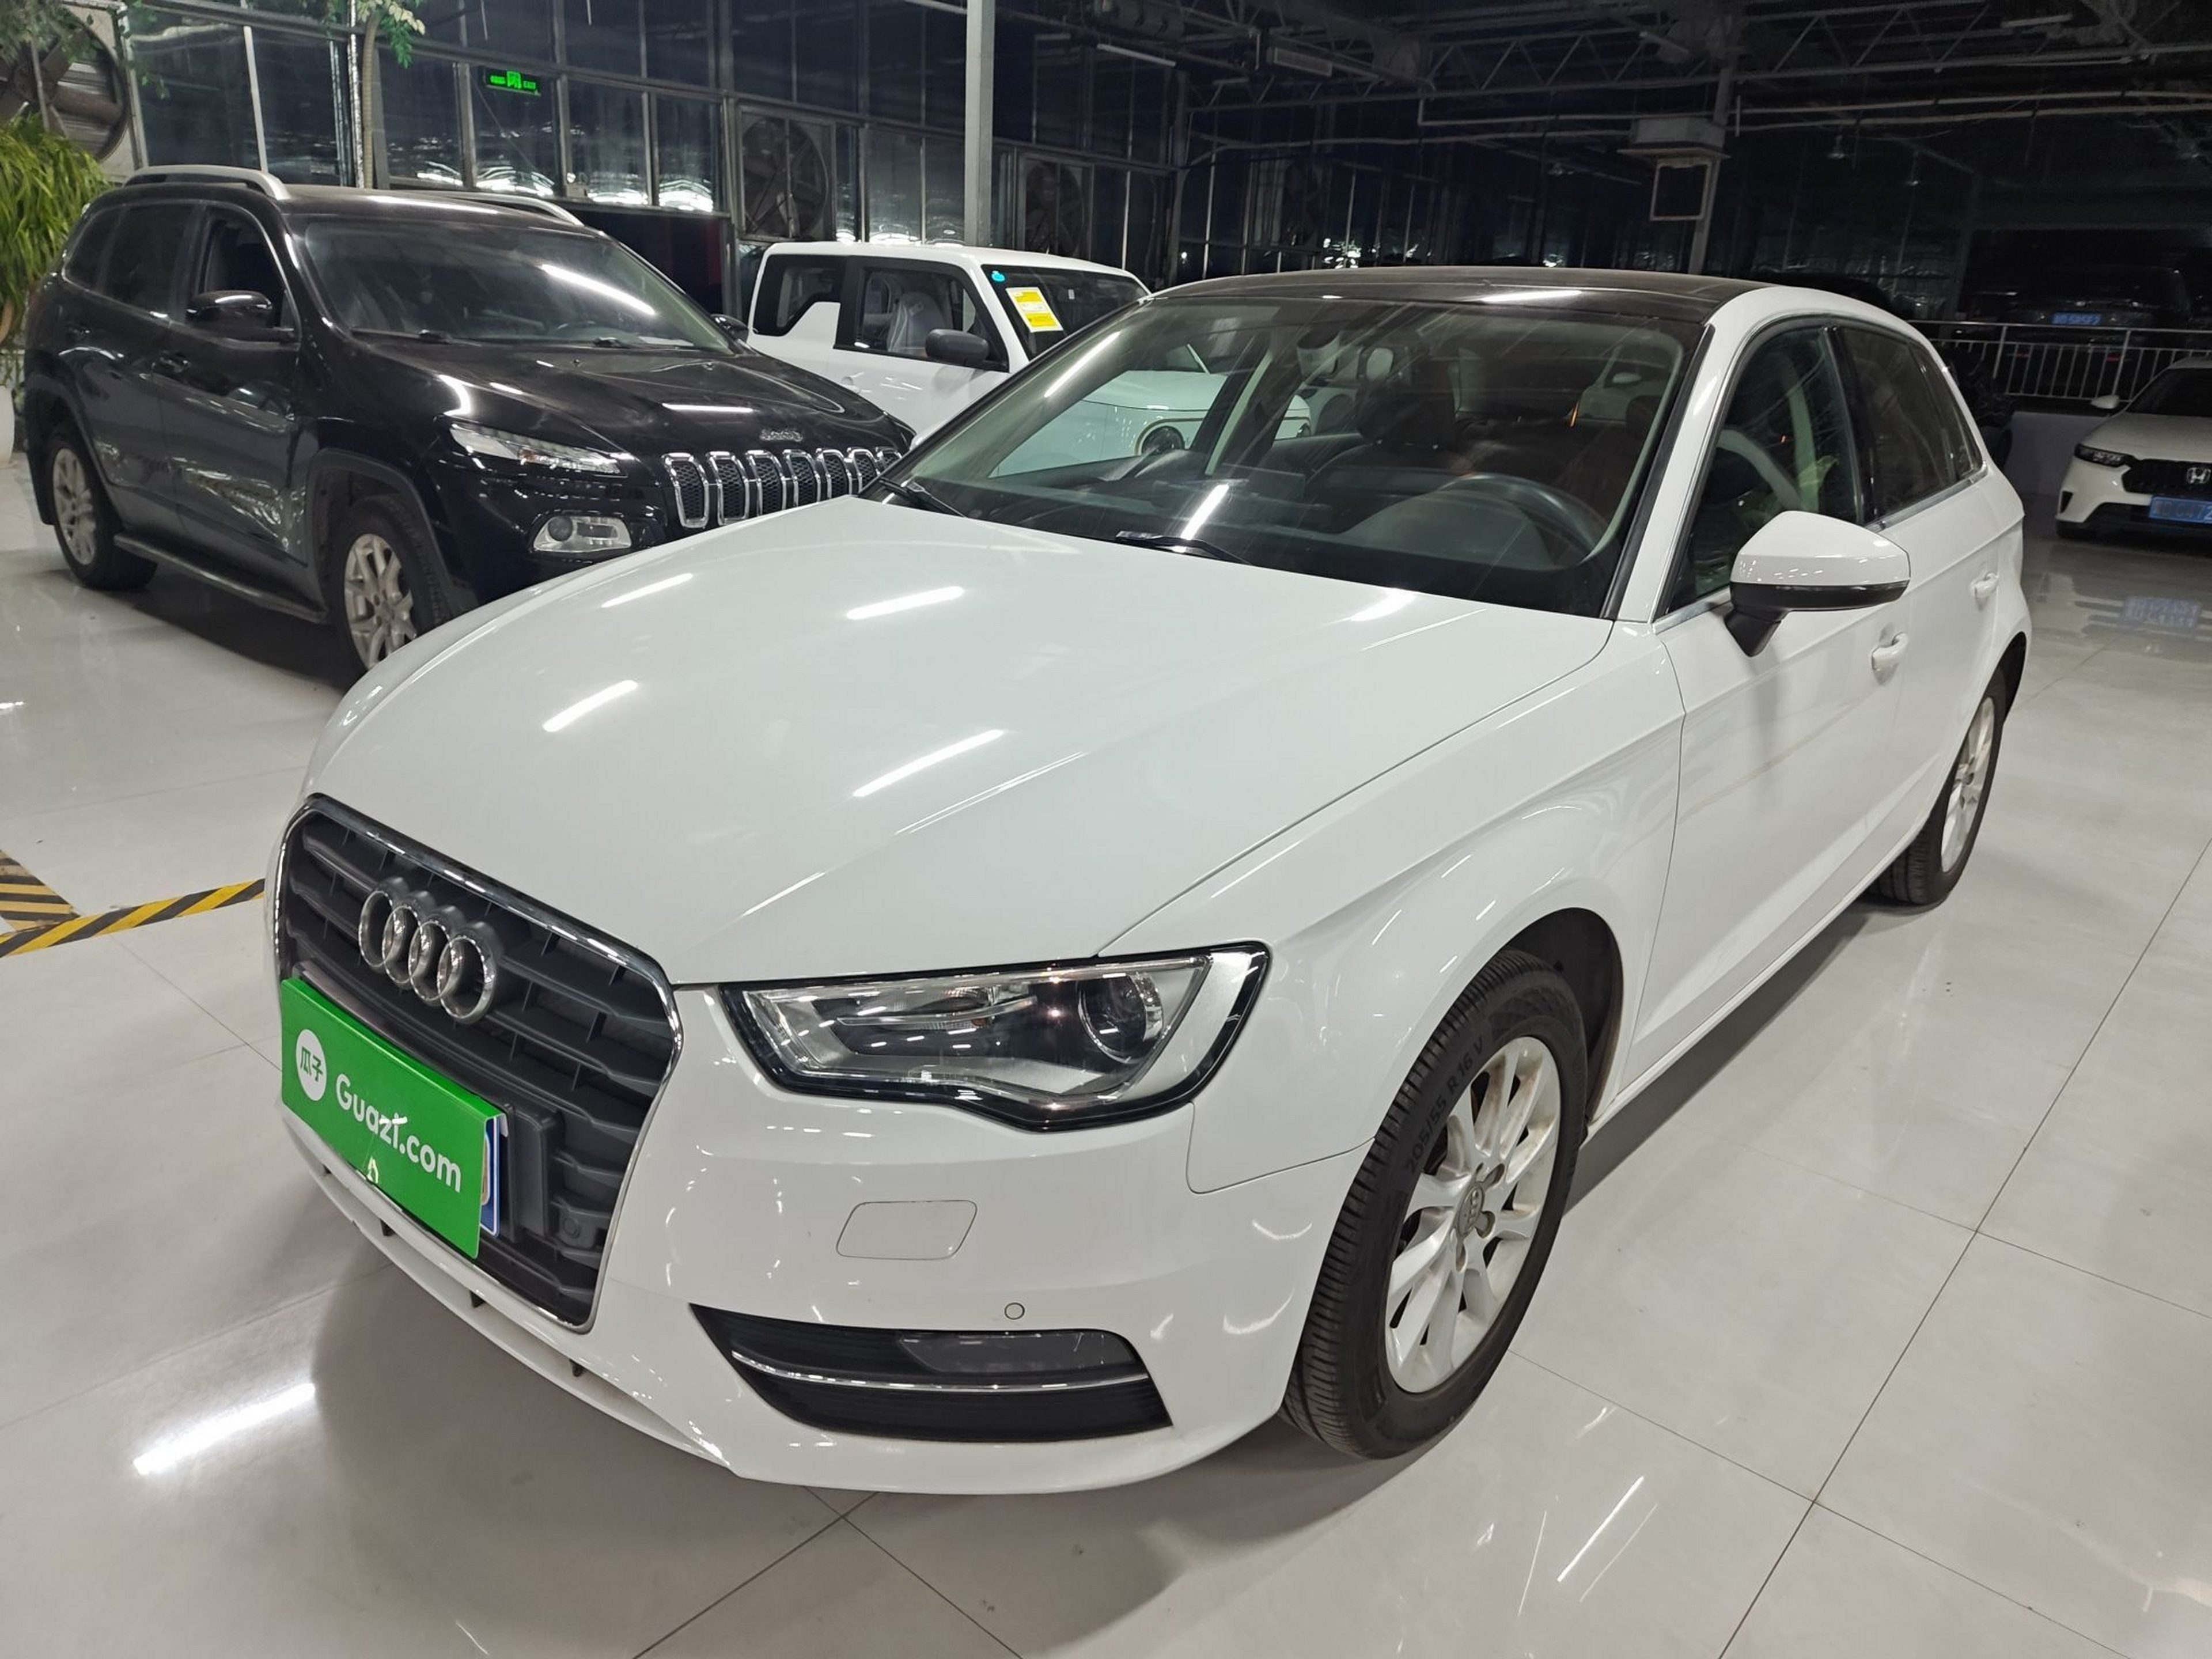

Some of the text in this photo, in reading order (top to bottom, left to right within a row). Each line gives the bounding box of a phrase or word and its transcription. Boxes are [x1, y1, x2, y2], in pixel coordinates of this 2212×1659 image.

[300, 1046, 324, 1082] 瓜子
[1403, 1037, 1483, 1174] 205/55 R 16 V
[336, 1073, 461, 1193] Guazi.com
